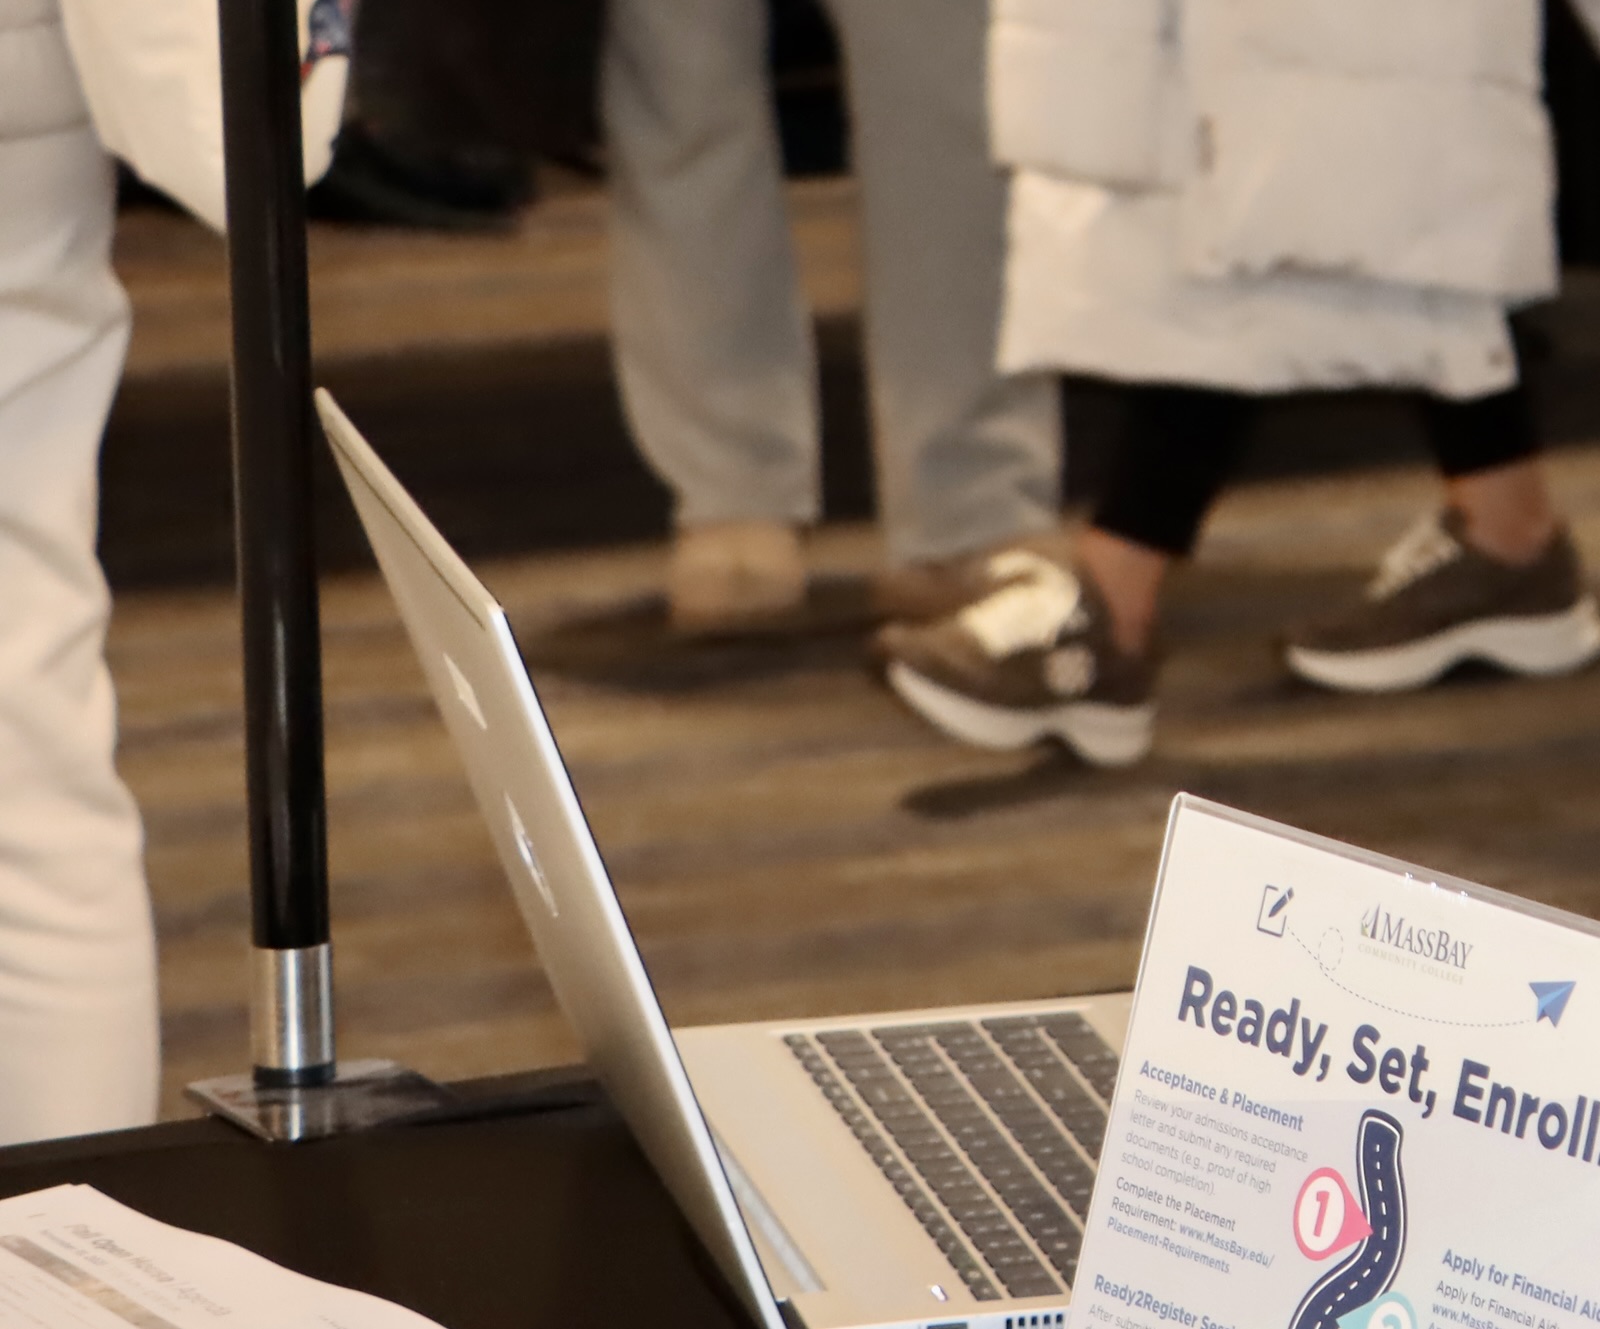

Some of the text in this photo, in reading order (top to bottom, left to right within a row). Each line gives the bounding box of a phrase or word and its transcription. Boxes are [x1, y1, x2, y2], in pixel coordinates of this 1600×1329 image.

[1178, 966, 1331, 1082] Ready,
[1346, 1024, 1437, 1119] Set,
[1134, 1089, 1308, 1163] Review your admissions acceptance
[1139, 1060, 1304, 1132] Acceptance & Placement
[1125, 1130, 1179, 1160] documents
[1207, 1161, 1235, 1180] proof
[1237, 1170, 1249, 1184] of
[1250, 1174, 1272, 1195] high
[1130, 1109, 1277, 1173] letter and submit any required
[1121, 1151, 1216, 1196] school completion).
[1111, 1196, 1275, 1269] Requirement: www.MassBay.edu/
[1116, 1176, 1236, 1232] Complete the Placement
[1313, 1190, 1330, 1238] 1
[1107, 1216, 1230, 1274] Placement-Requirements
[1094, 1274, 1198, 1328] Ready2Register
[1436, 1280, 1468, 1305] Apply
[1471, 1292, 1486, 1309] for
[1488, 1298, 1536, 1328] Financial
[1442, 1249, 1484, 1281] Apply
[1487, 1264, 1509, 1287] for
[1511, 1273, 1578, 1312] Financial
[1088, 1304, 1113, 1323] After
